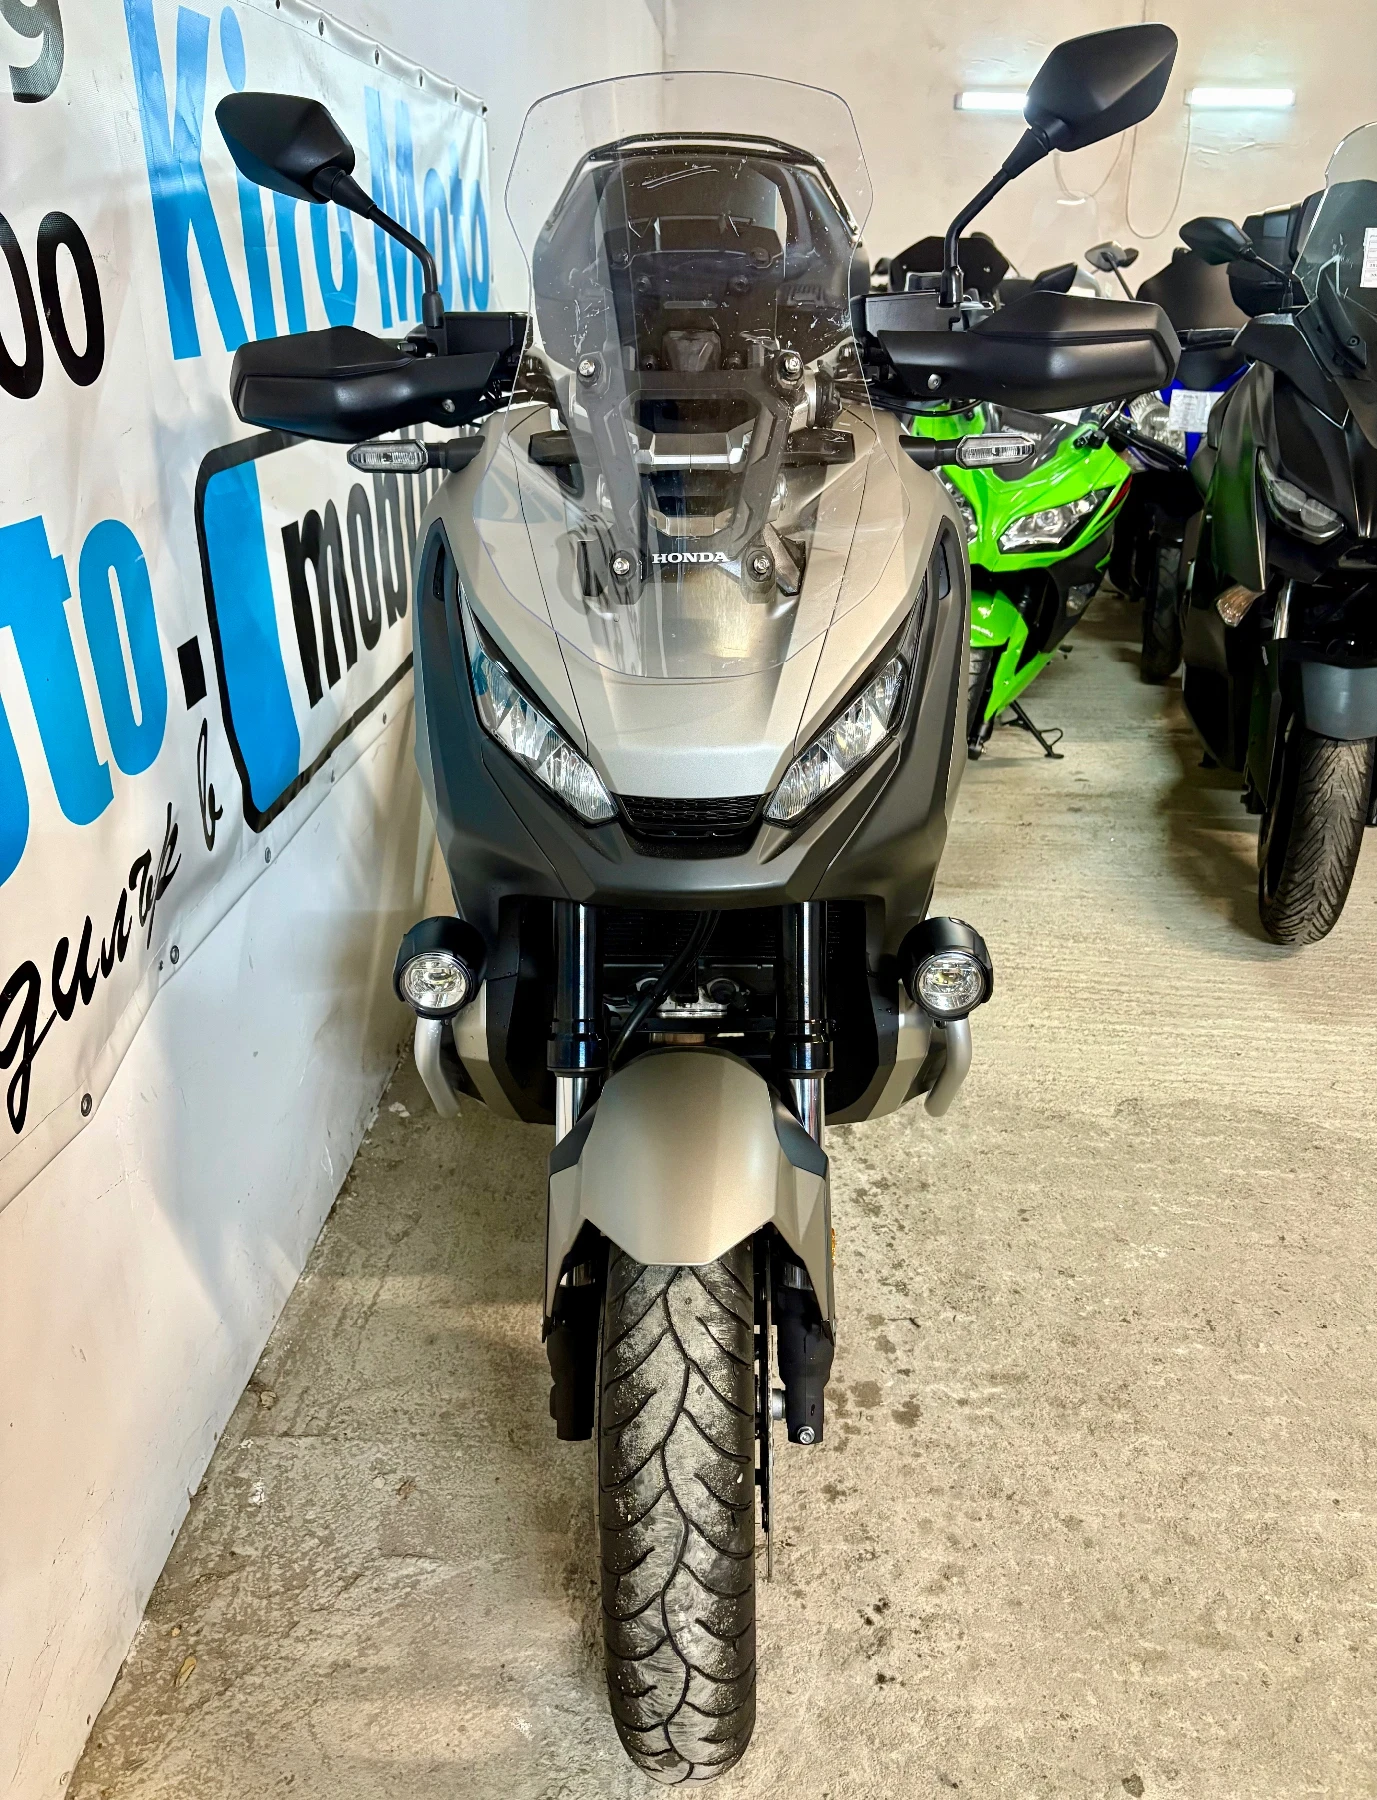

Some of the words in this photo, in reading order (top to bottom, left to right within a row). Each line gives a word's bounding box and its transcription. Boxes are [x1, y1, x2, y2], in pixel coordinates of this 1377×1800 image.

[123, 0, 358, 361] Kiro
[364, 86, 490, 330] Moto
[652, 552, 731, 564] HONDA
